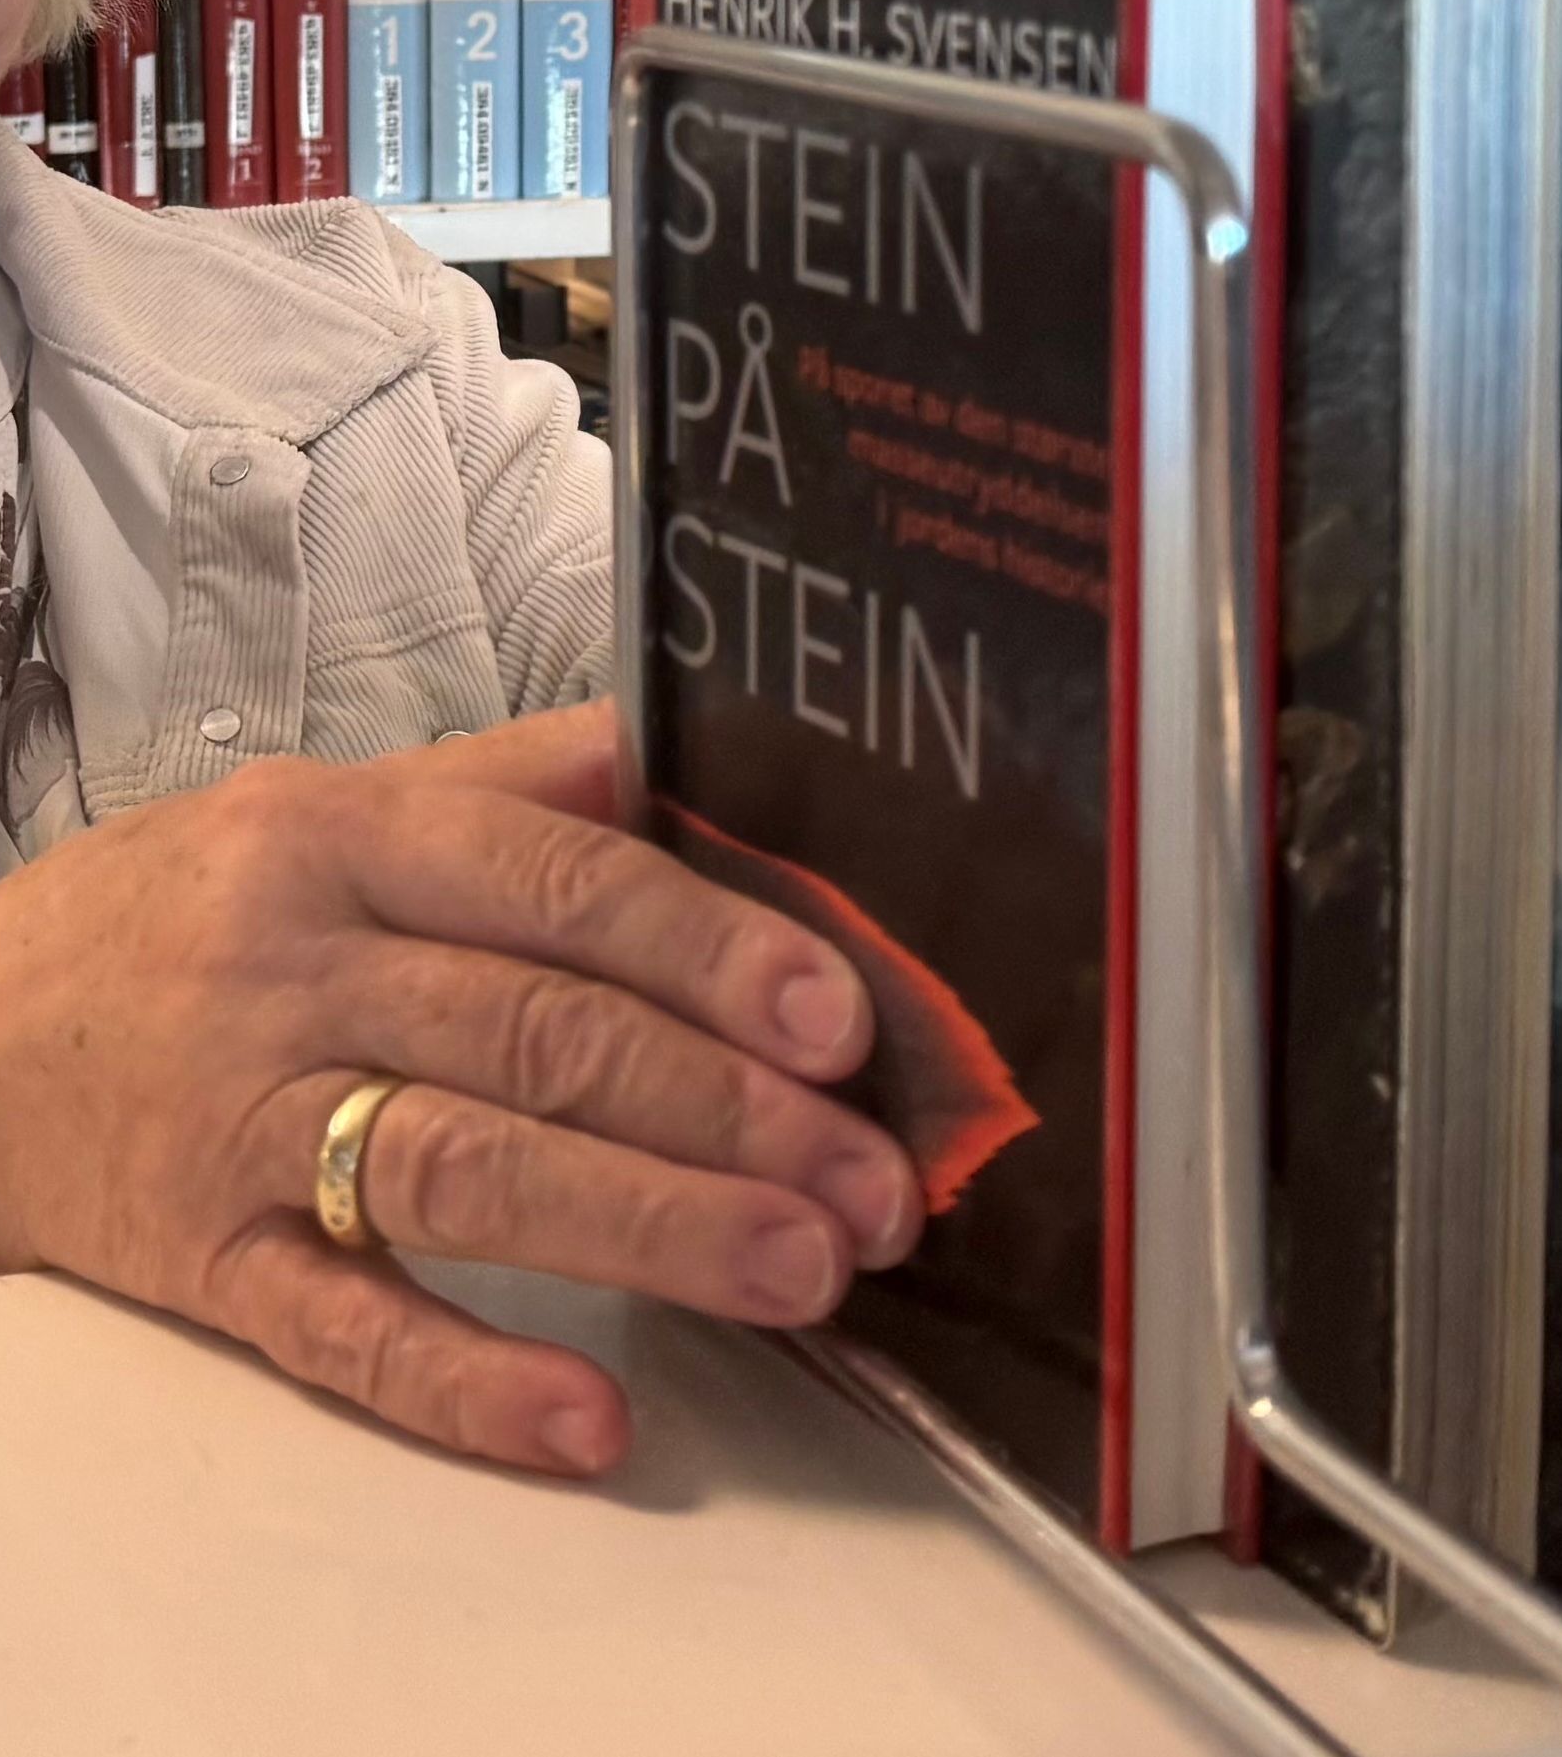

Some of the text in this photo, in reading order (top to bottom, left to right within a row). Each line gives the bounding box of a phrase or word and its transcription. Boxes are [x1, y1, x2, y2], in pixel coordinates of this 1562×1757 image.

[381, 15, 400, 67] 1
[466, 9, 499, 62] 2
[555, 10, 589, 62] 3
[884, 0, 1118, 98] SVENSEN
[662, 100, 983, 336] STEIN
[667, 302, 793, 508] PÅ
[662, 511, 981, 802] STEIN
